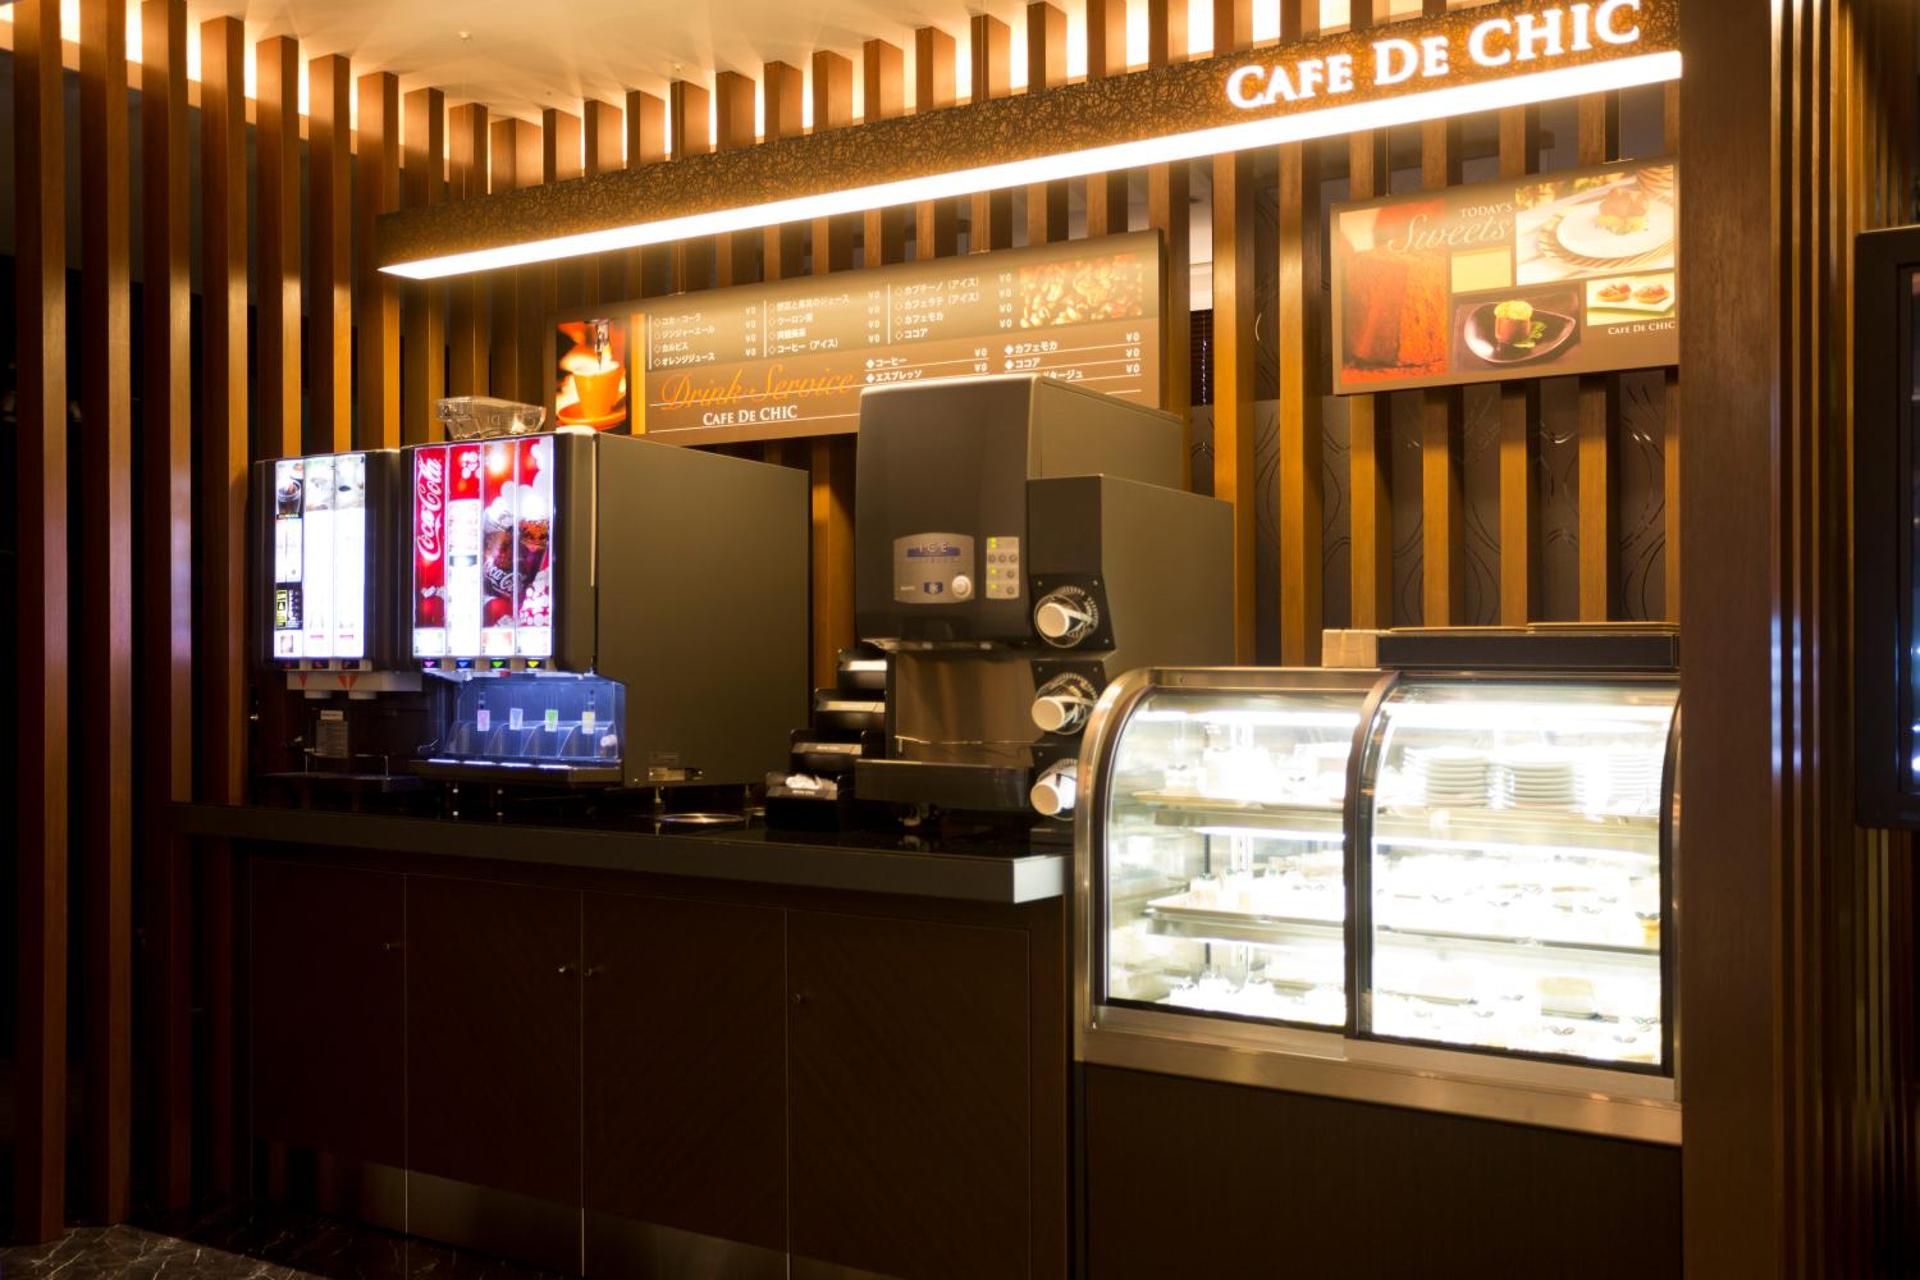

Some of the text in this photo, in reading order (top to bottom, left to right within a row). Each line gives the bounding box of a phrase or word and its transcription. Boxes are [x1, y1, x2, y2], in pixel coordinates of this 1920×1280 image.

[1227, 2, 1641, 109] CAFE DE CHIC
[1460, 202, 1513, 219] TODAY'S
[1387, 213, 1511, 252] Sweets
[1015, 340, 1058, 354] カフェモカ
[875, 357, 908, 367] コーヒー
[1015, 357, 1041, 369] ココア
[660, 364, 855, 411] Drink Service
[703, 405, 798, 426] CAFE DE CHIC
